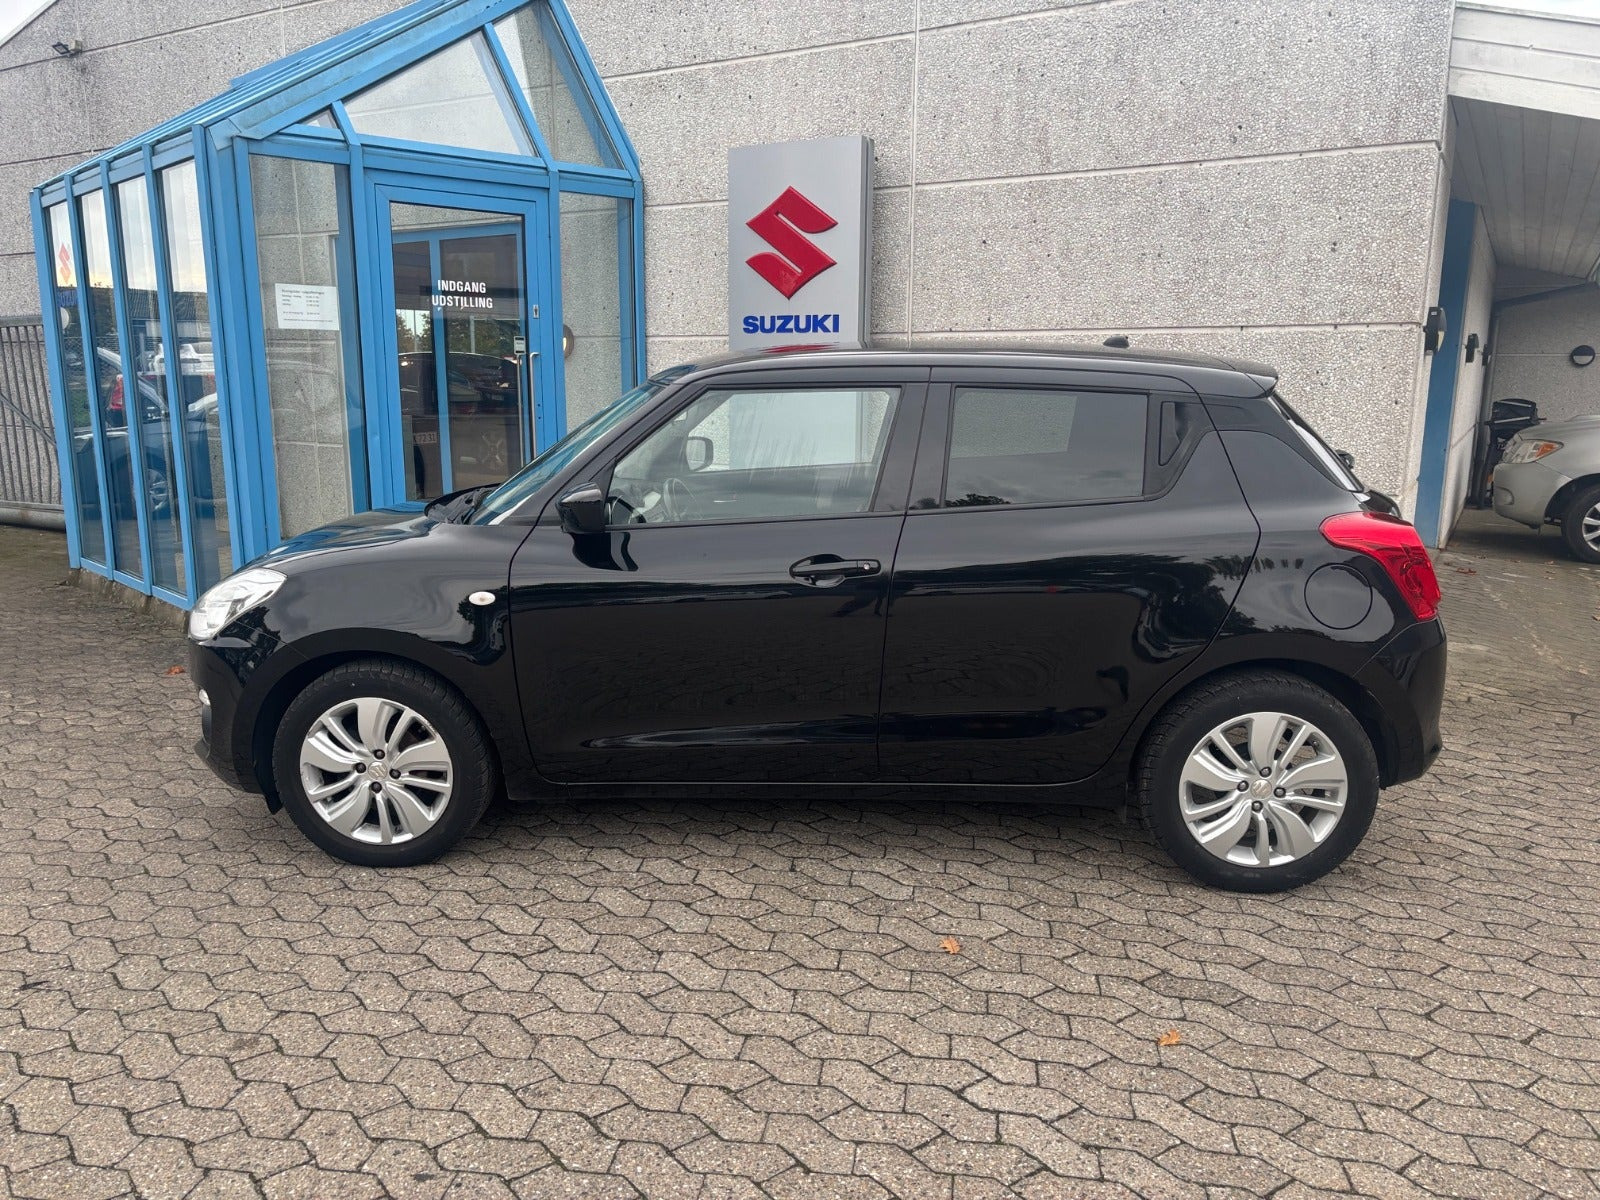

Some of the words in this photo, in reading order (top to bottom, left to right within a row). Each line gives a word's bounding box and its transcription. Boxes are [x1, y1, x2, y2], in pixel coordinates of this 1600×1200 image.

[438, 280, 486, 294] INDGANG
[431, 295, 493, 309] UDSTILLING
[743, 314, 840, 334] SUZUKI
